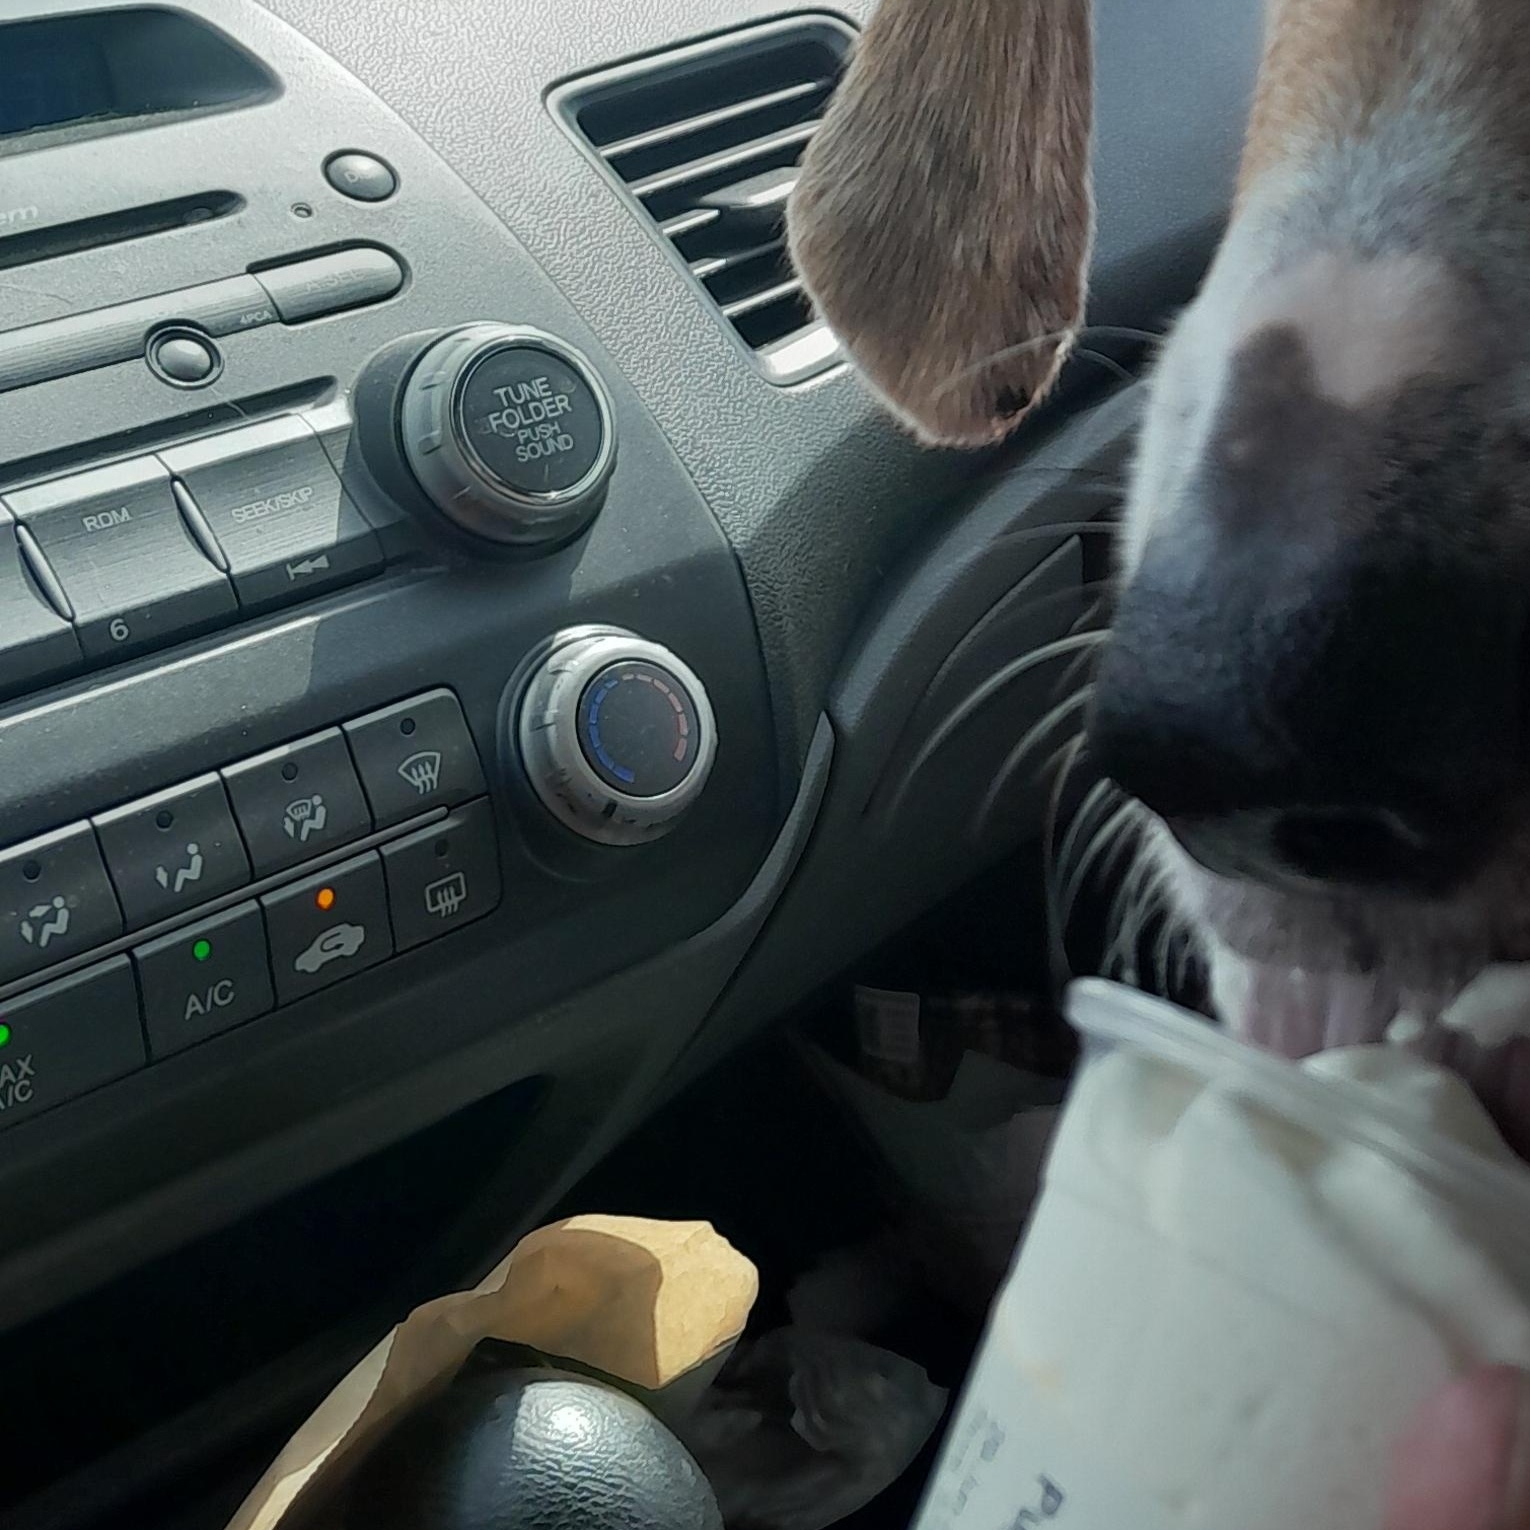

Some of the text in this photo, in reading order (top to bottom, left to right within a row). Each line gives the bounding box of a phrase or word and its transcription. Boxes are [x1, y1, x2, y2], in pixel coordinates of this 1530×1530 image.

[493, 376, 552, 407] TUNE
[488, 394, 573, 433] FOLDER
[515, 433, 574, 462] SOUND
[517, 421, 561, 444] PUSH
[82, 507, 132, 532] RDM
[231, 487, 313, 524] SEEK/SKIP
[109, 619, 129, 641] 6
[185, 979, 235, 1020] A/C
[0, 1054, 35, 1088] AX
